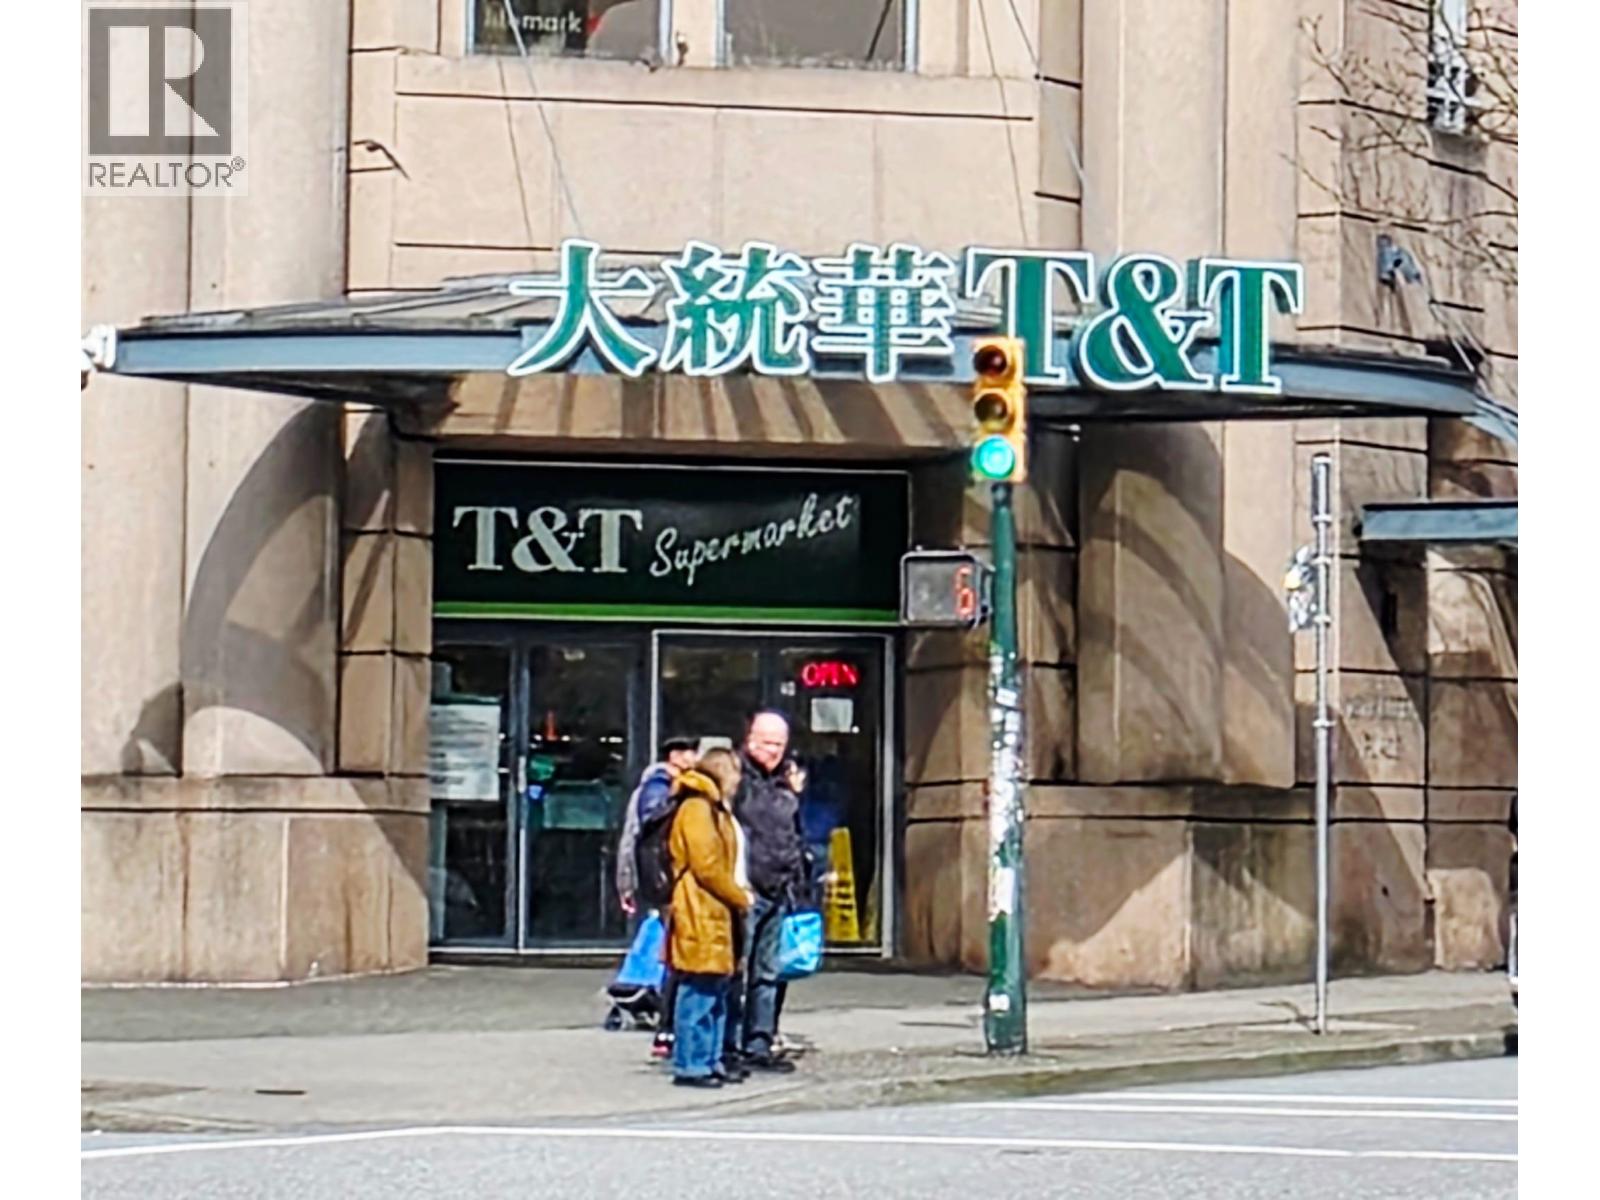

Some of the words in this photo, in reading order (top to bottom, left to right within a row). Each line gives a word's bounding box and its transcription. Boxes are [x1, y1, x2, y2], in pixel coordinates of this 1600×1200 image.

[507, 238, 956, 382] 大統華
[964, 246, 1304, 394] T&T
[453, 505, 643, 573] T&T
[649, 492, 853, 586] Supermarket
[954, 565, 976, 617] 6
